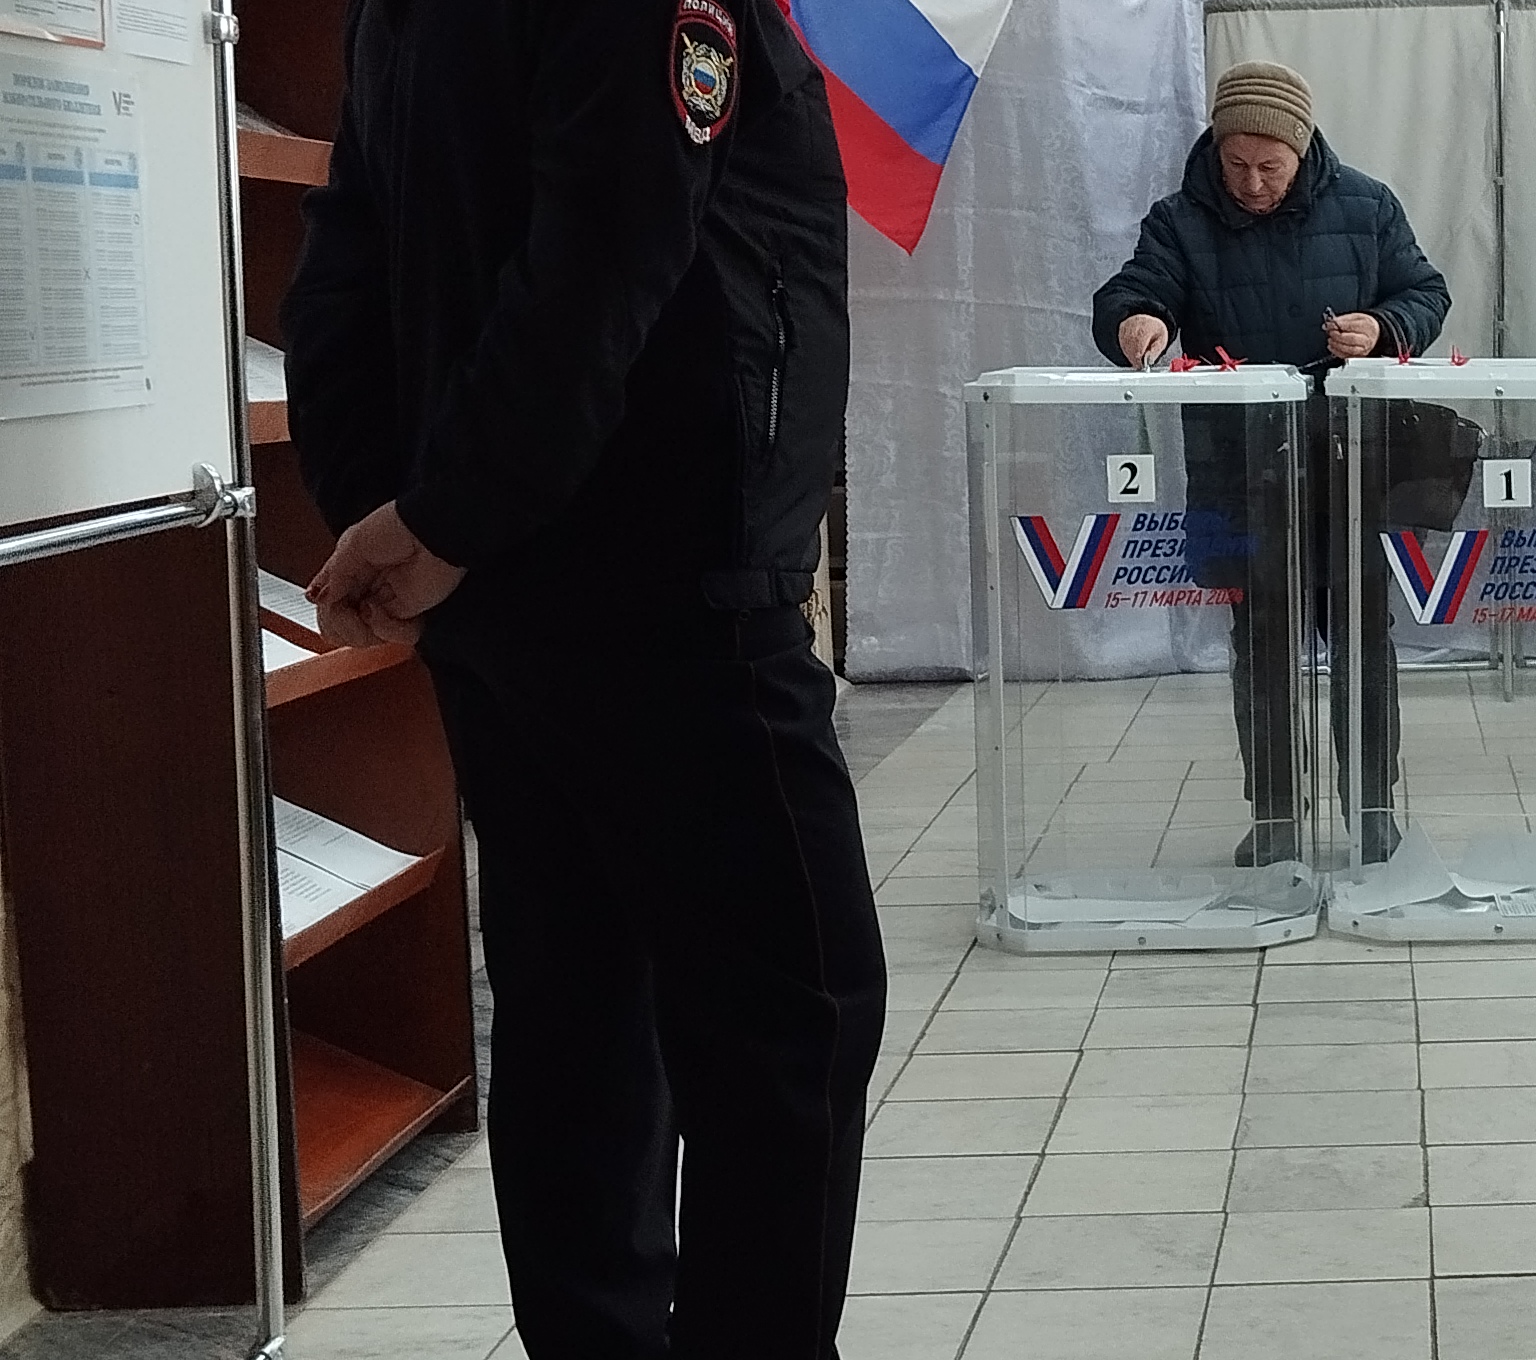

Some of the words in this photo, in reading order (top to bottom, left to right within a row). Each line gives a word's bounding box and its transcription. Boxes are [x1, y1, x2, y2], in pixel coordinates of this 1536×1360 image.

[1119, 462, 1140, 495] 2
[1500, 469, 1516, 501] 1
[1149, 589, 1203, 608] МАРТА
